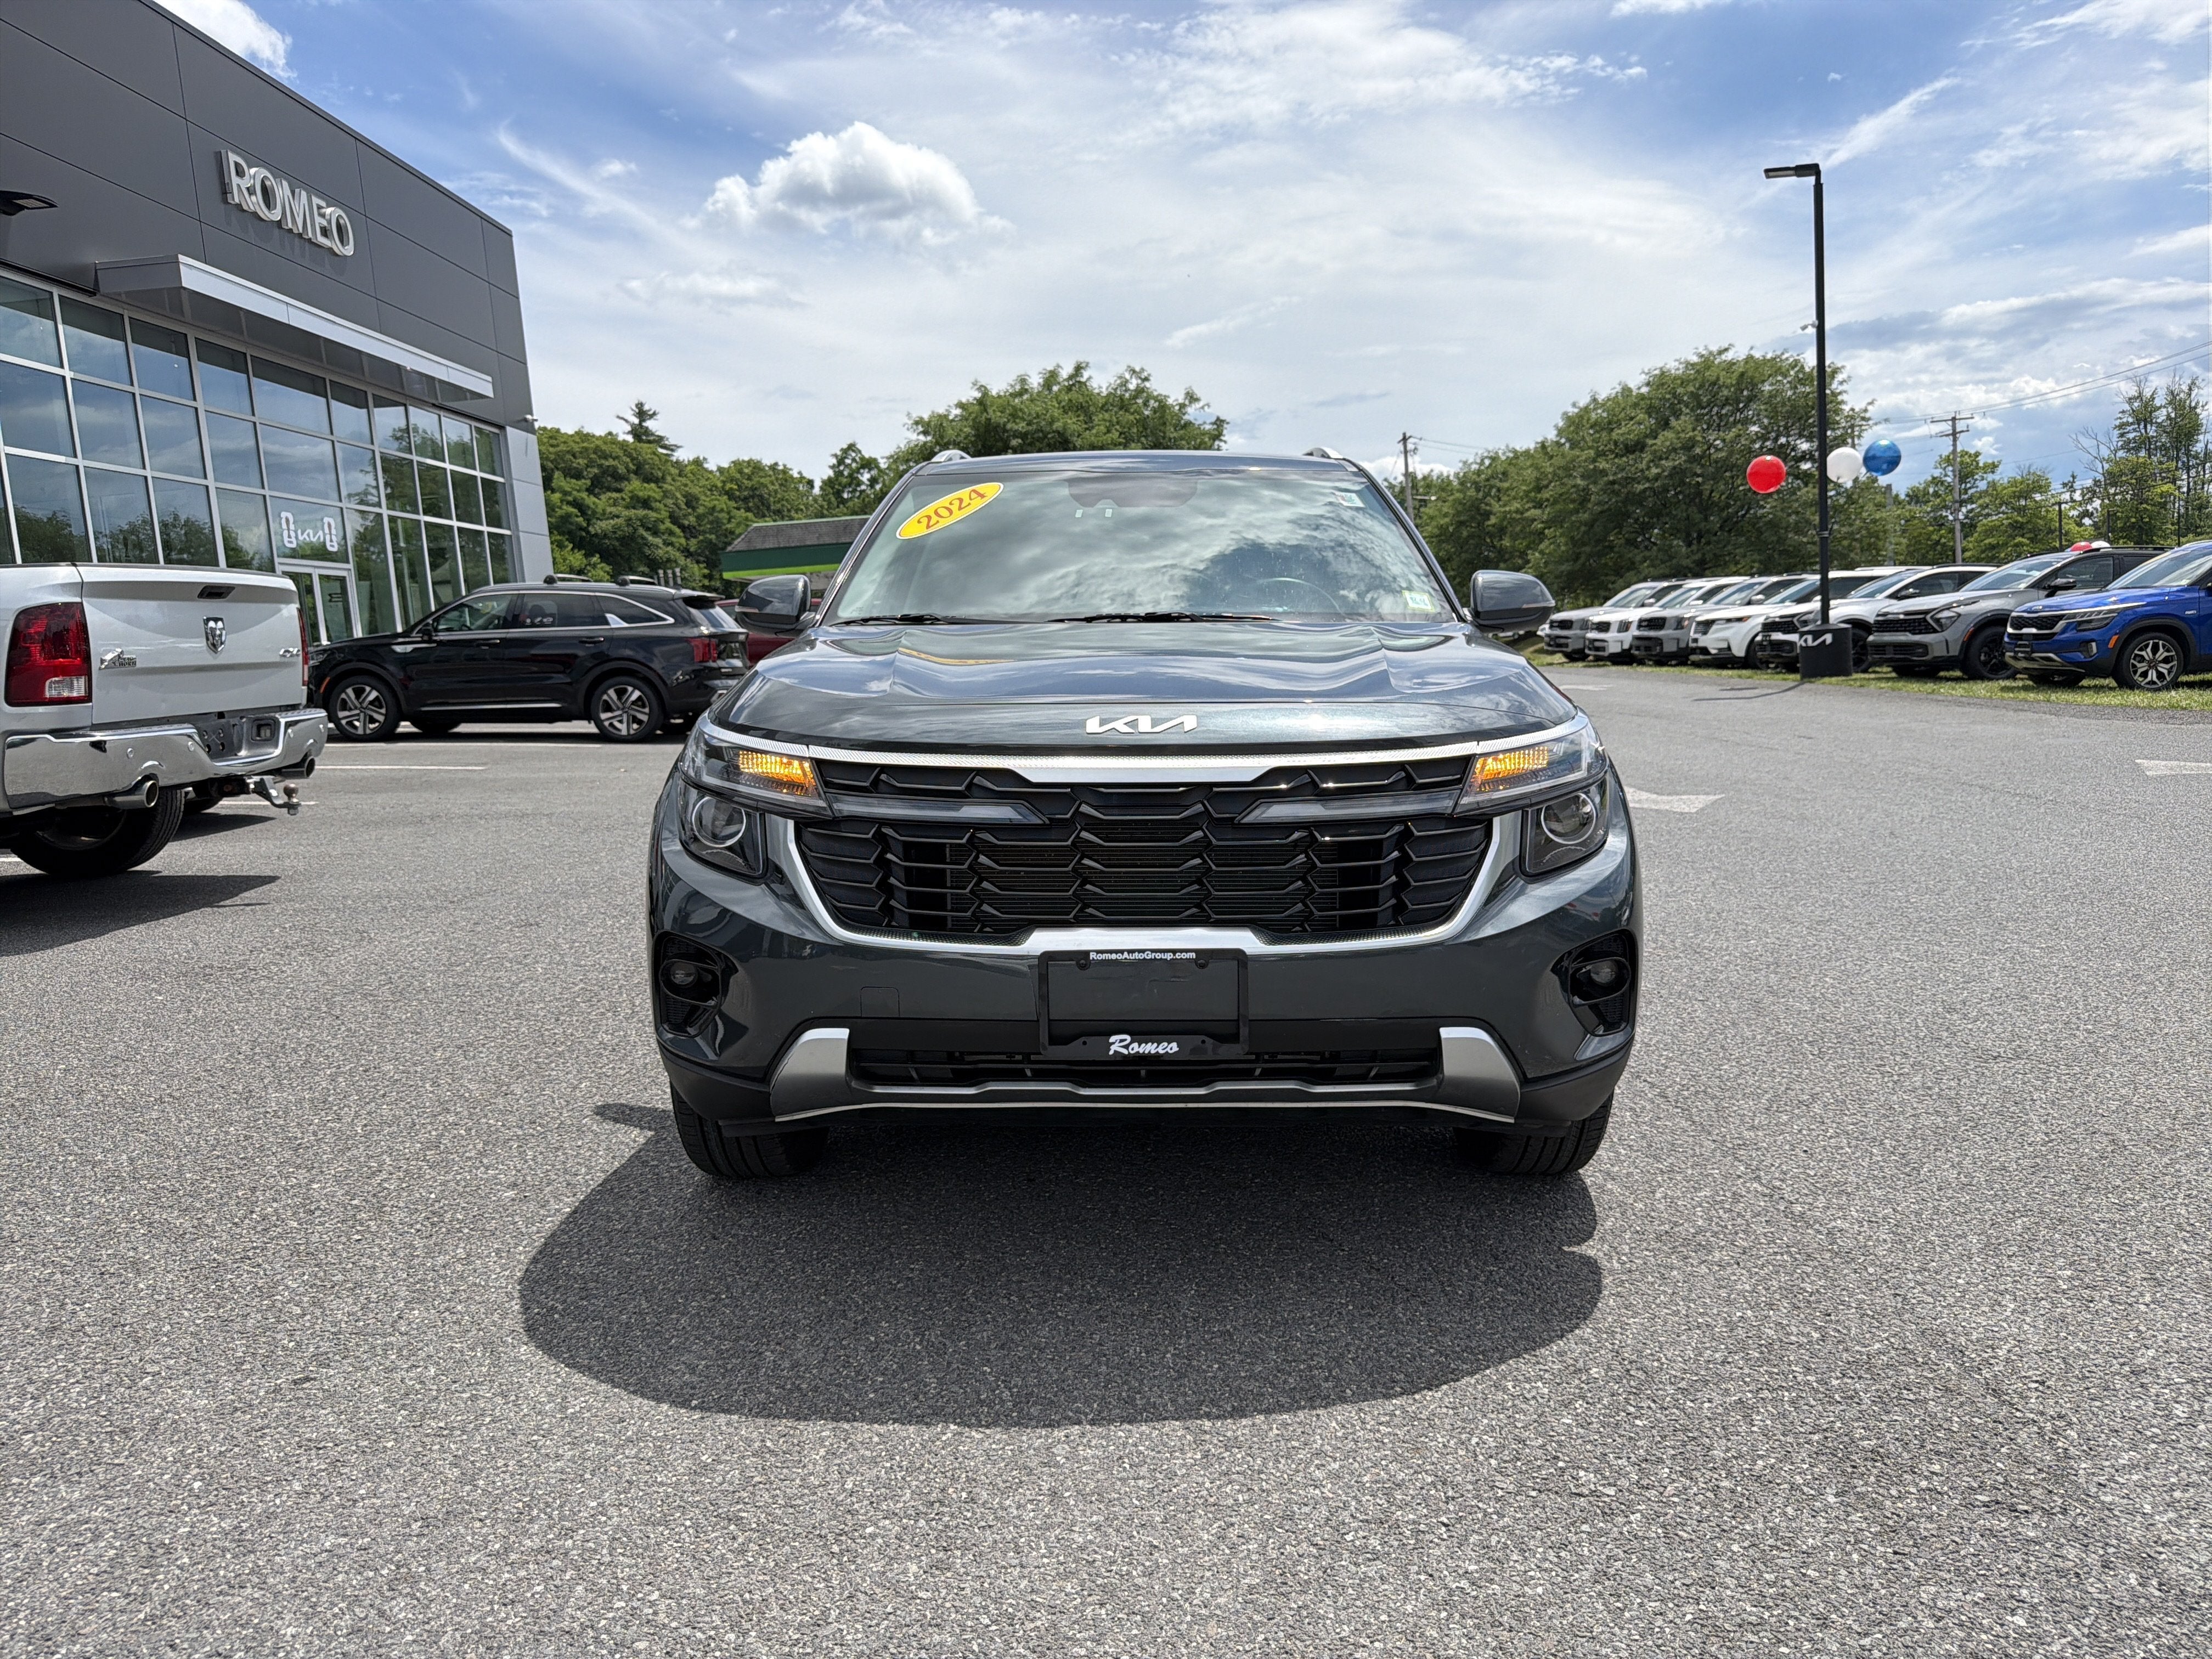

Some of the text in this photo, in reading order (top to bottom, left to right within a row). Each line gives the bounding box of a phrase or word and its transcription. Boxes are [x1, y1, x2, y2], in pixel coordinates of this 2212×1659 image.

[221, 149, 354, 256] ROMEO
[917, 489, 988, 529] 2024
[1086, 715, 1197, 734] KIA
[1089, 951, 1197, 961] RomeoAutoGroup.com
[1108, 1034, 1180, 1056] Romeo
